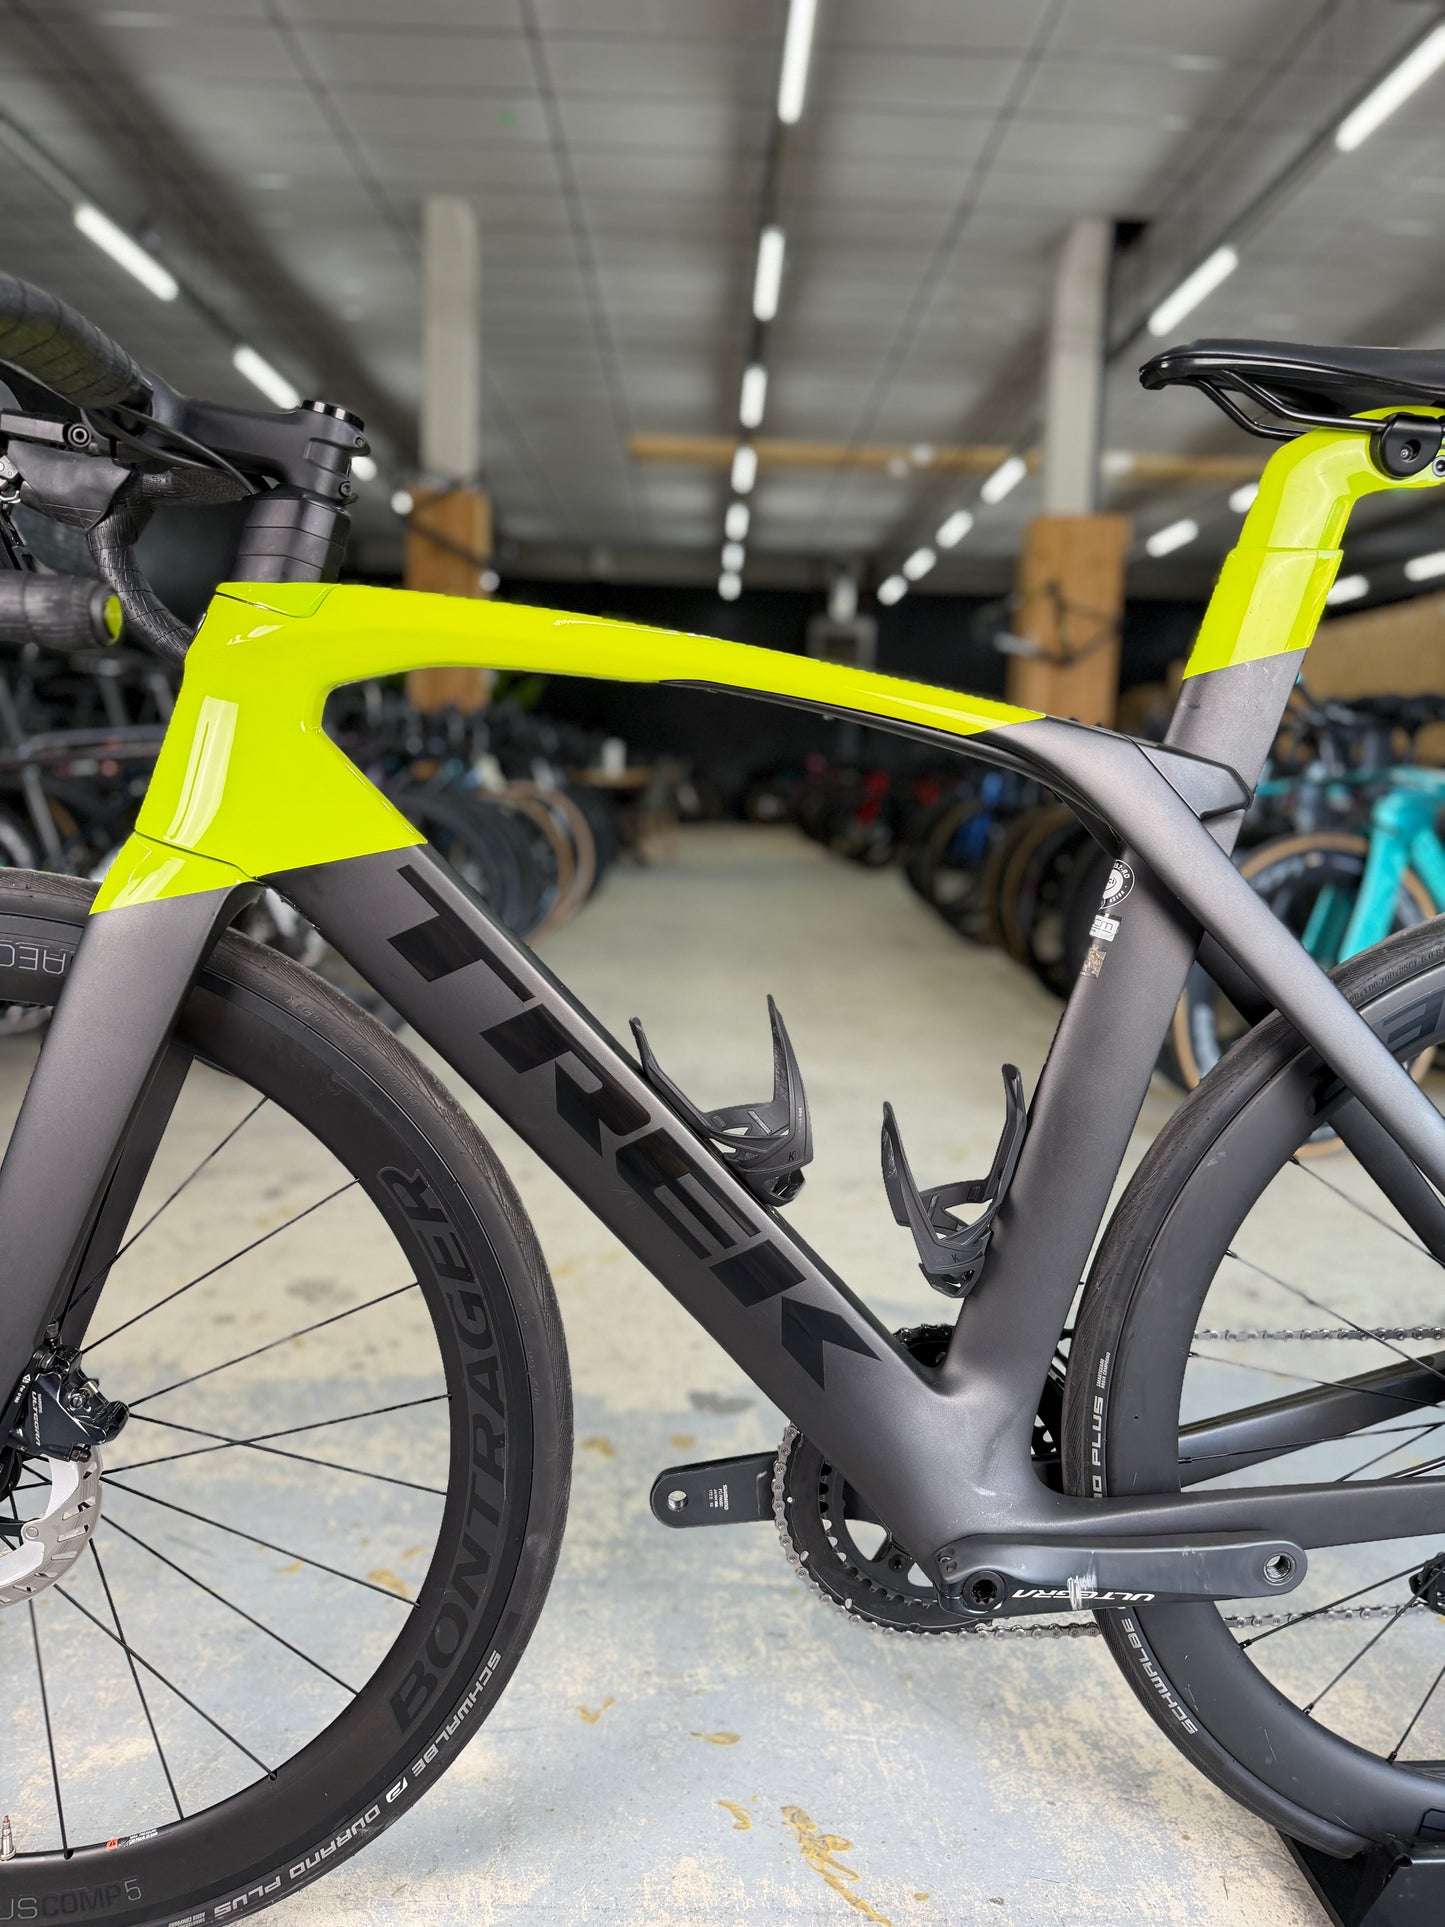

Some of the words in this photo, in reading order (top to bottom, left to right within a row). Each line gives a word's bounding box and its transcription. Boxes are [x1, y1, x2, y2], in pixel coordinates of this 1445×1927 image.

[387, 865, 881, 1391] TREK
[32, 1391, 41, 1447] ULTEGRA
[377, 1165, 508, 1735] BONTRAGER
[1091, 1395, 1105, 1467] PLUS
[1011, 1588, 1156, 1602] ULTEGRA
[414, 1649, 502, 1779] SCHWALBE
[1120, 1617, 1198, 1735] SCHWALBE
[289, 1804, 381, 1880] DURANO
[213, 1875, 283, 1919] PLUS
